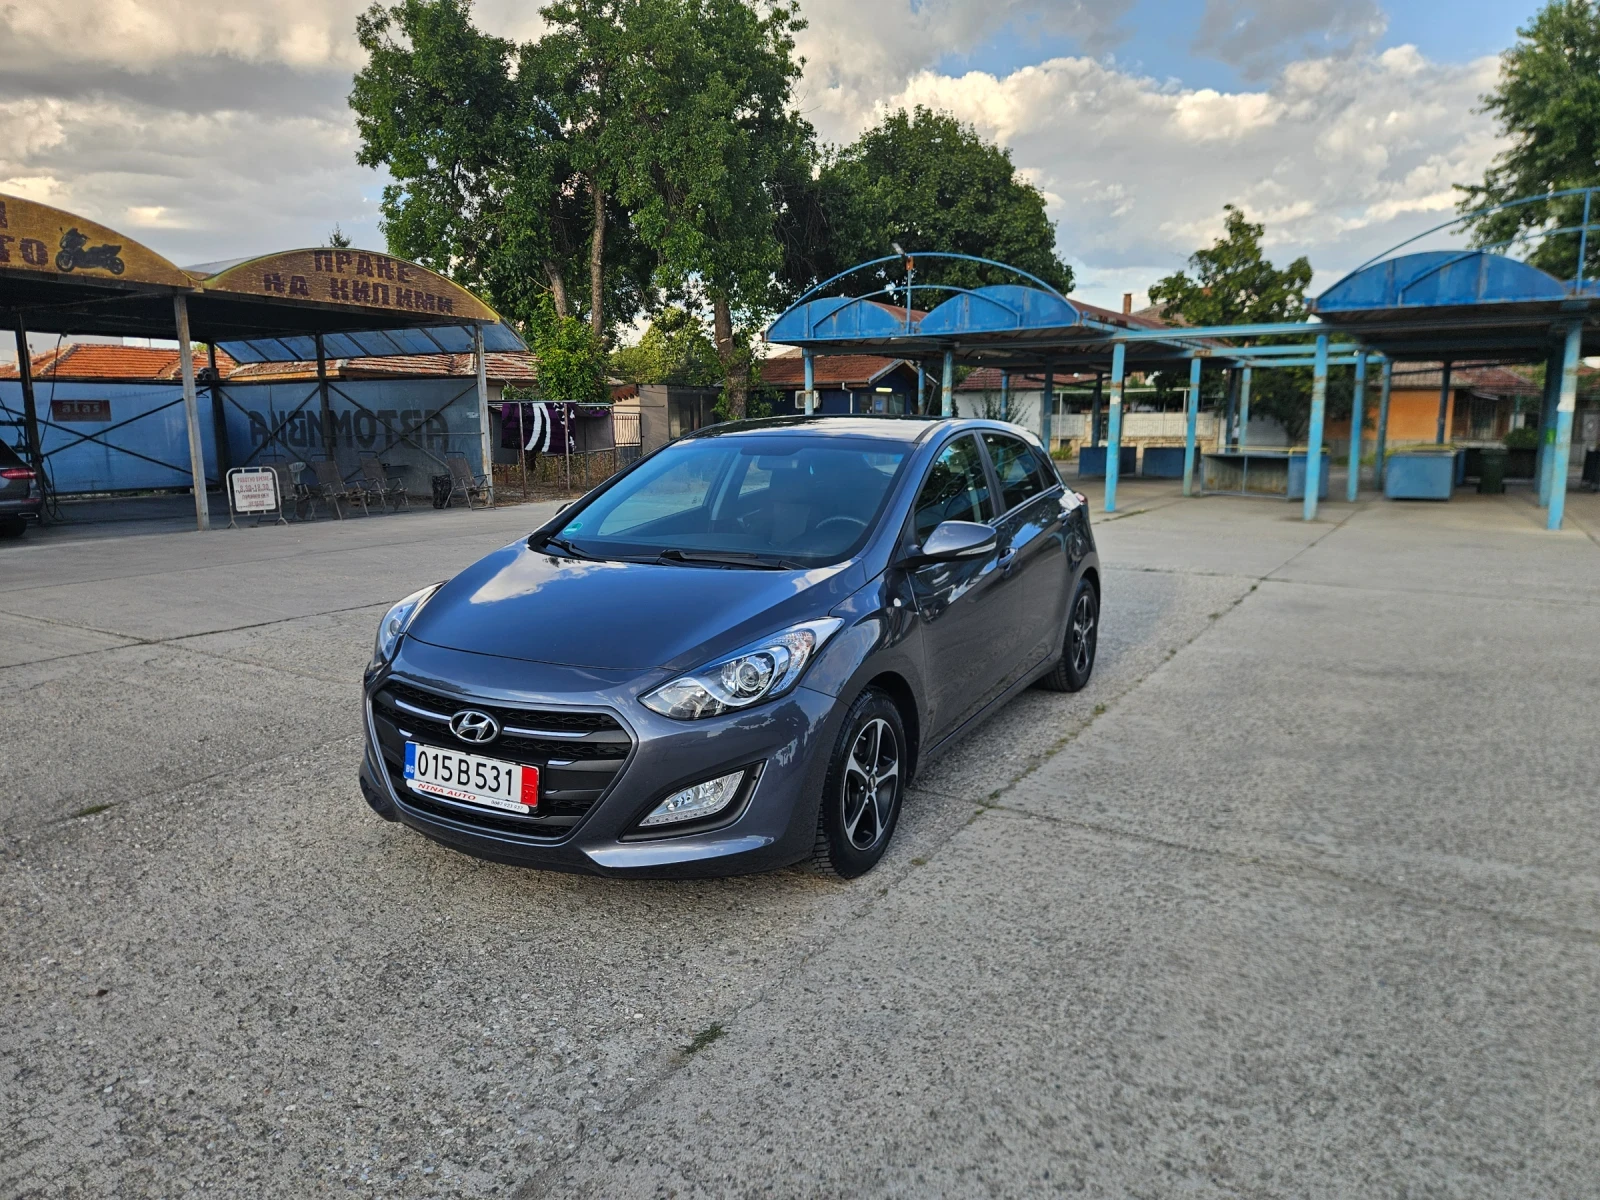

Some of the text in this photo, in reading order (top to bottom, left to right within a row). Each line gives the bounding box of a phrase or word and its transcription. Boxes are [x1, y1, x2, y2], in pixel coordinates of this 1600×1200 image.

[314, 250, 411, 283] ПРАНЕ
[264, 273, 453, 313] НА КИЛИМИ
[405, 764, 415, 774] BG
[418, 750, 513, 796] 015B531
[417, 783, 477, 801] NINA AUTO
